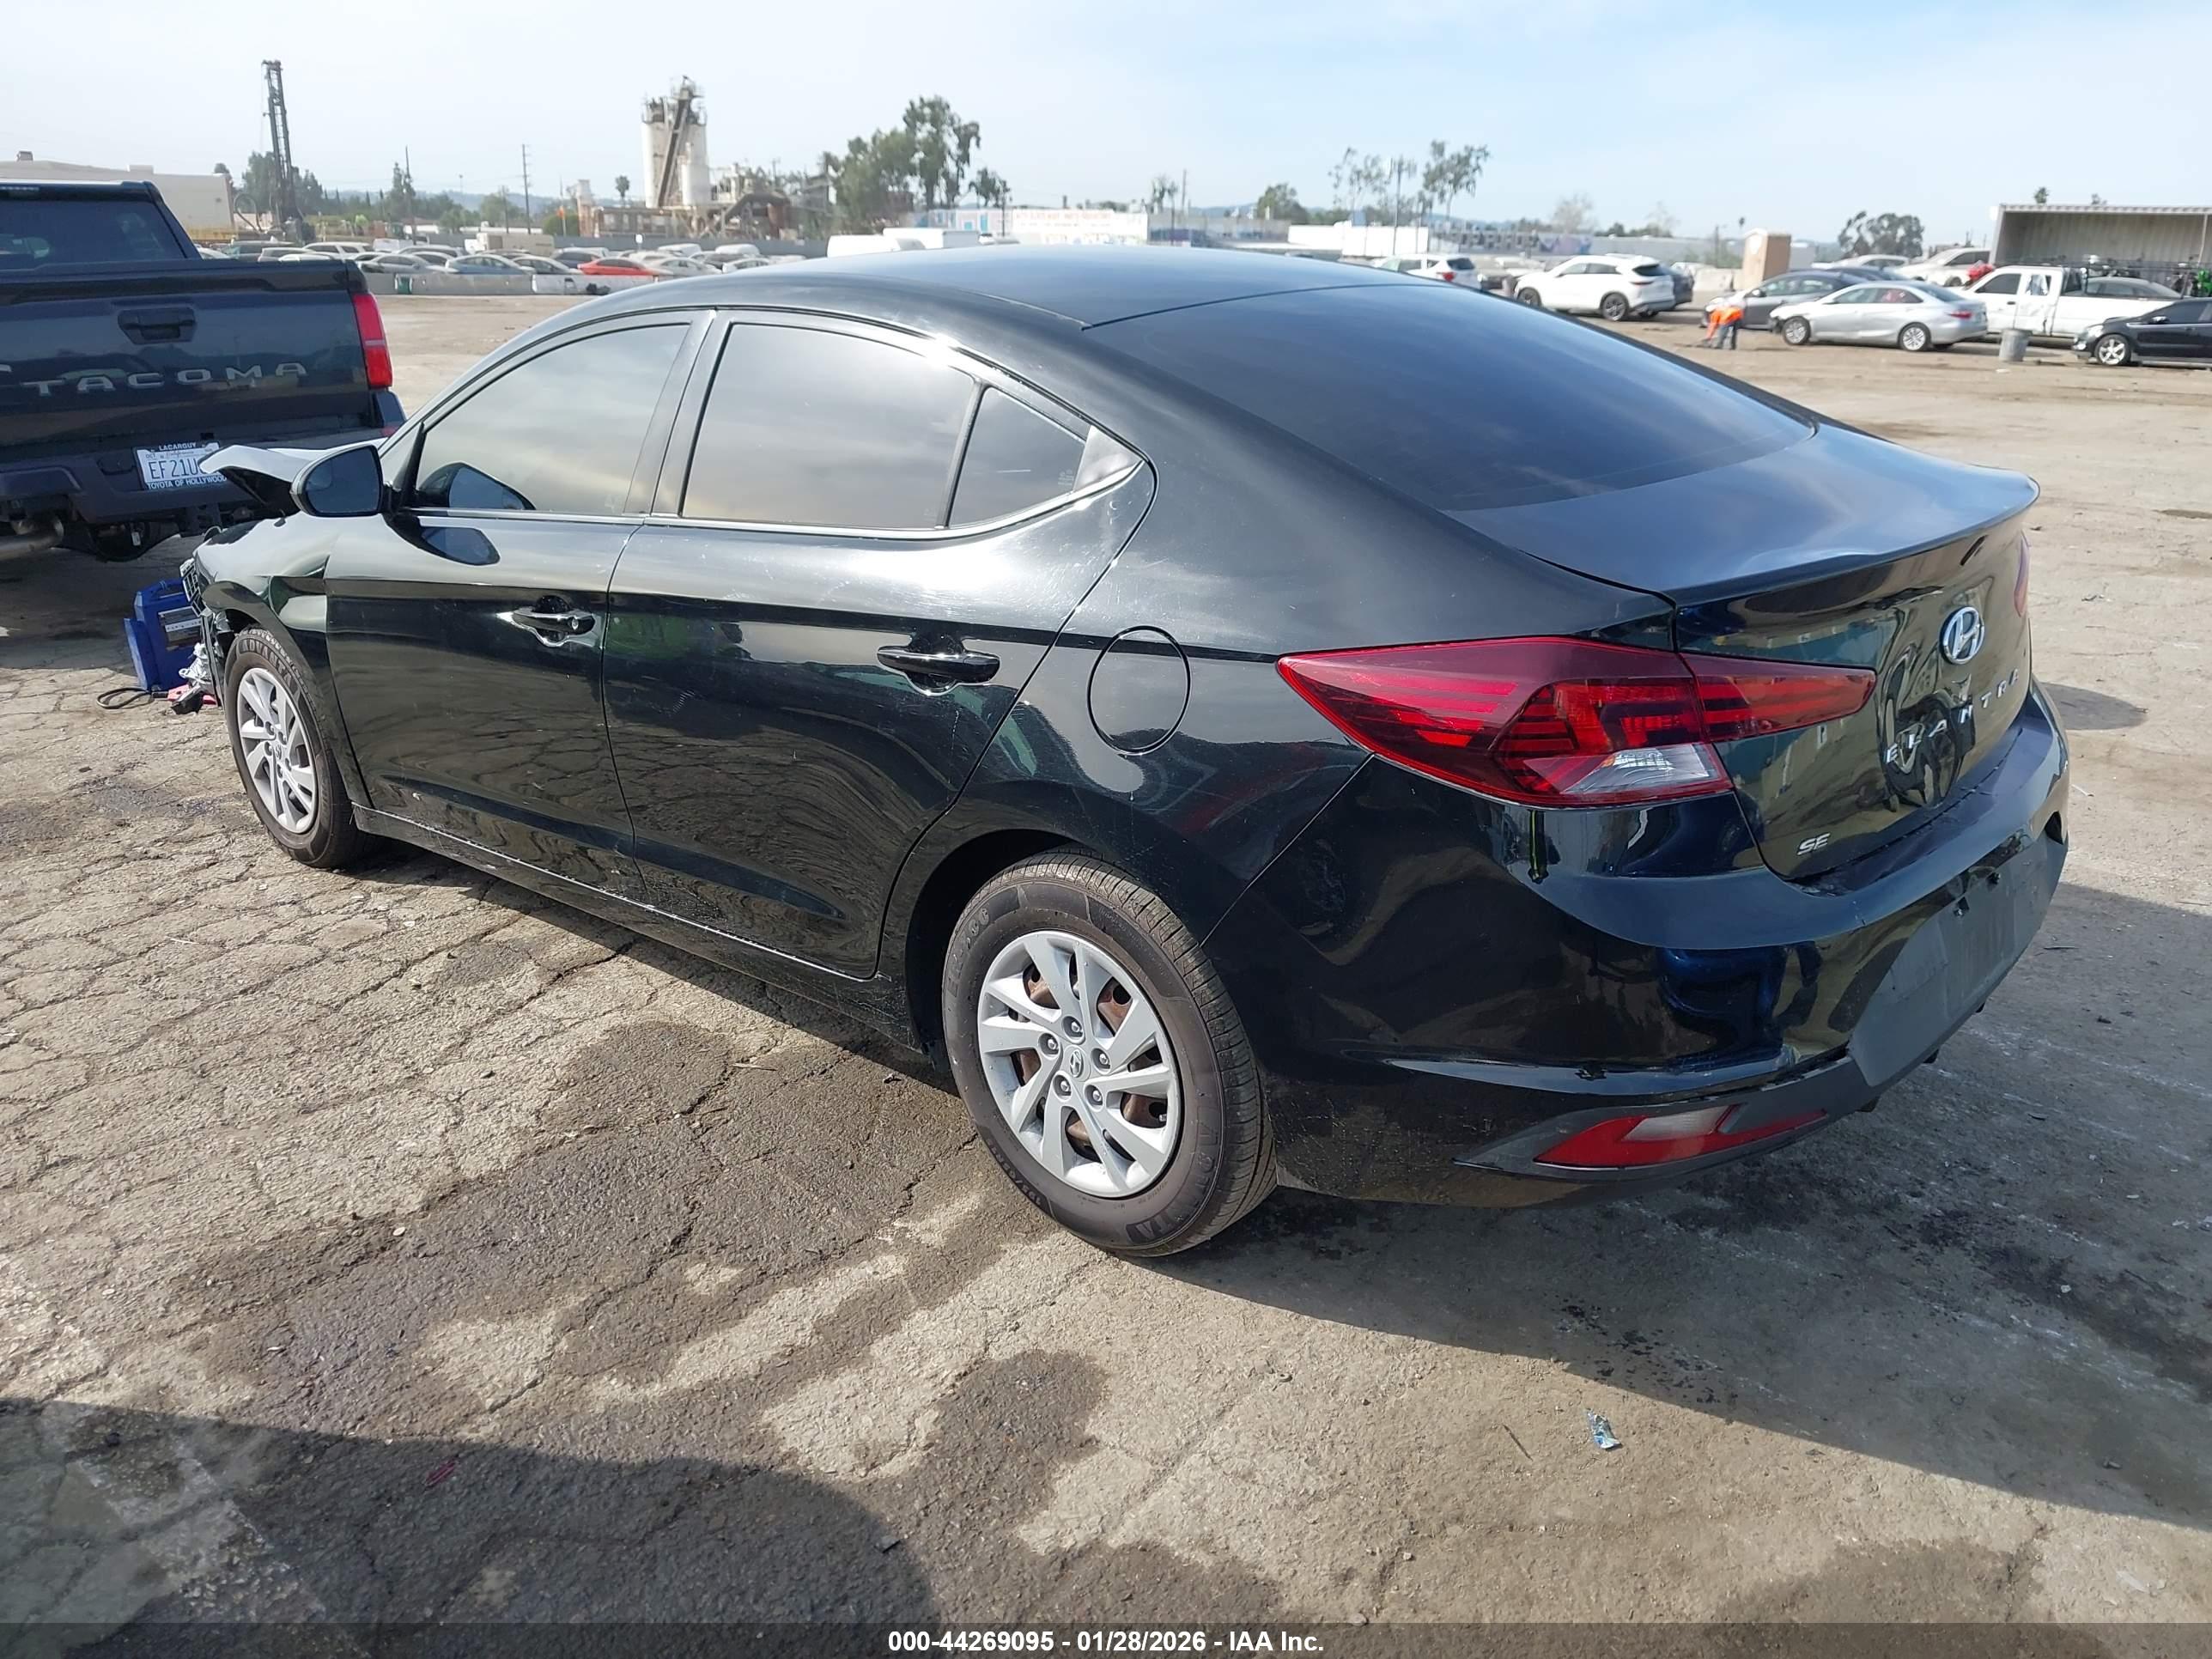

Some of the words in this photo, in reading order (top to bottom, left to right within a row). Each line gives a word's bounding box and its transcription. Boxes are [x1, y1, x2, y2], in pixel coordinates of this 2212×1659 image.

[21, 362, 307, 396] TACOMA
[159, 442, 197, 451] LACARGUY
[149, 458, 207, 479] EF21U
[147, 481, 173, 489] TOYOTA
[241, 638, 293, 688] ADVANTA
[1796, 833, 1831, 856] SE
